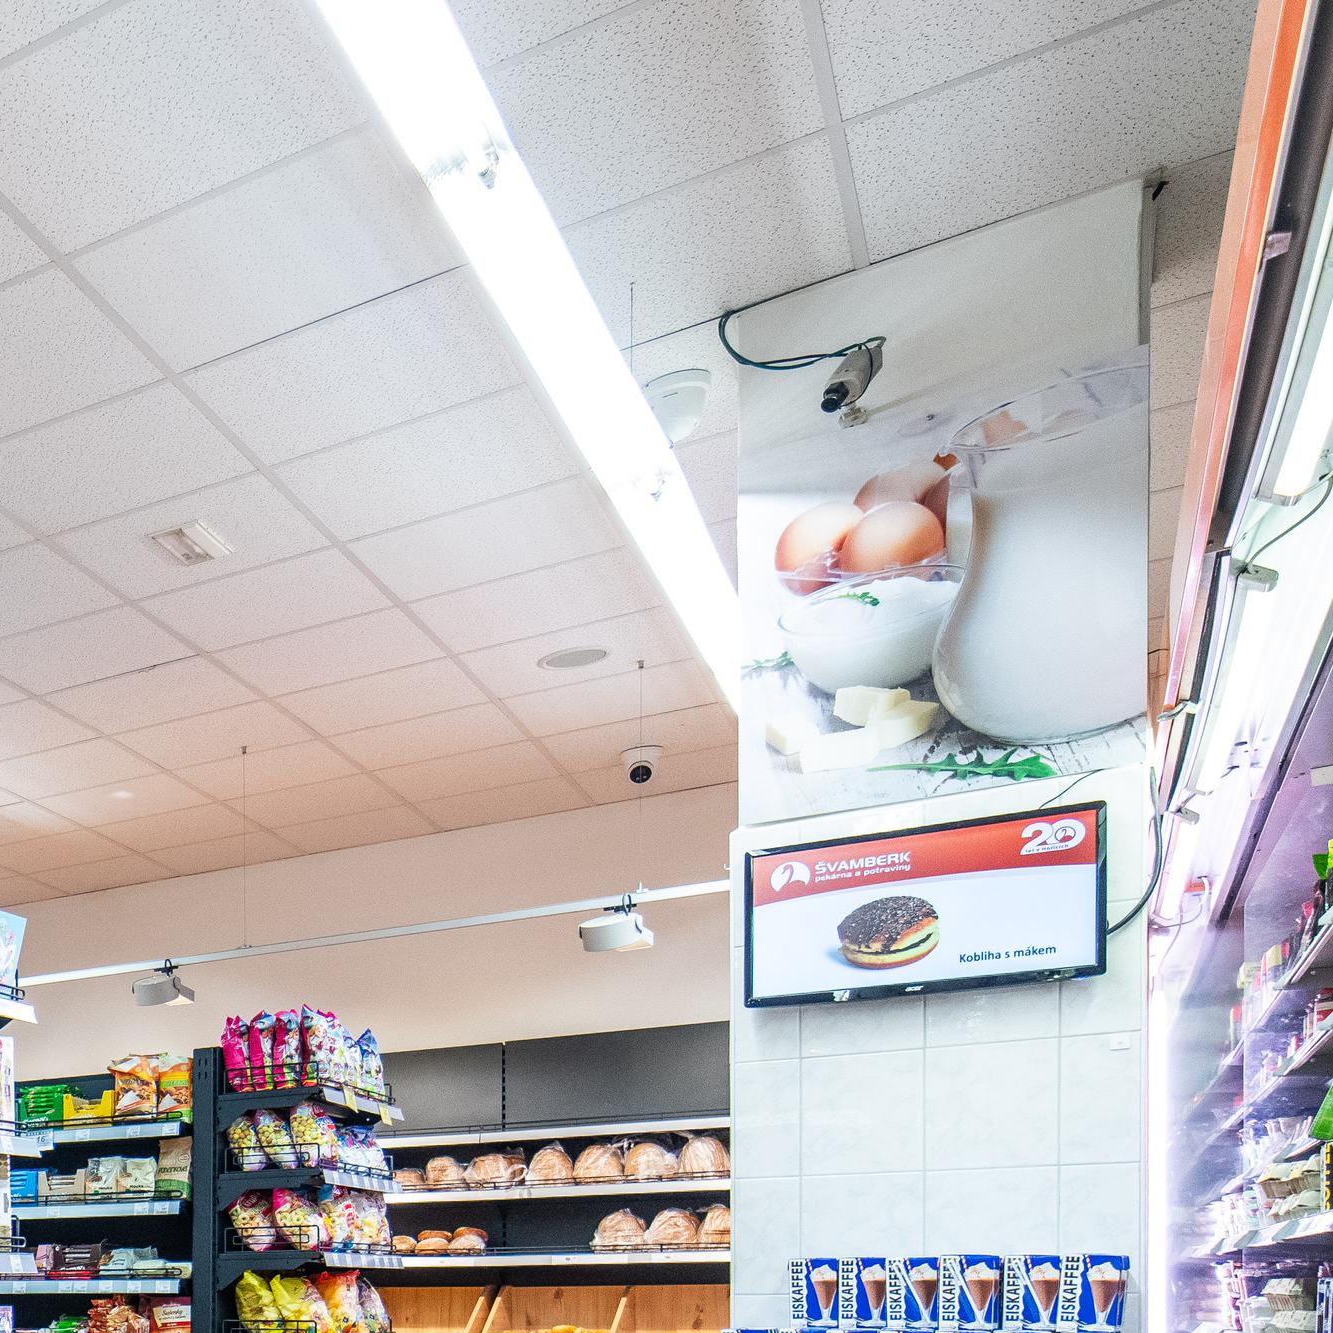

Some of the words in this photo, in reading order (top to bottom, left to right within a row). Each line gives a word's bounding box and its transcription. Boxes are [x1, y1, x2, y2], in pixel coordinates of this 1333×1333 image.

[814, 871, 852, 884] pekárna
[864, 864, 911, 879] potraviny
[815, 851, 911, 875] ŠVAMBERK
[959, 950, 1001, 963] Kobliha
[1014, 945, 1056, 958] mákem
[792, 1259, 803, 1319] EISKAFFEE
[843, 1259, 854, 1319] EISKAFFEE
[1061, 1255, 1080, 1323] EISKAFFEE
